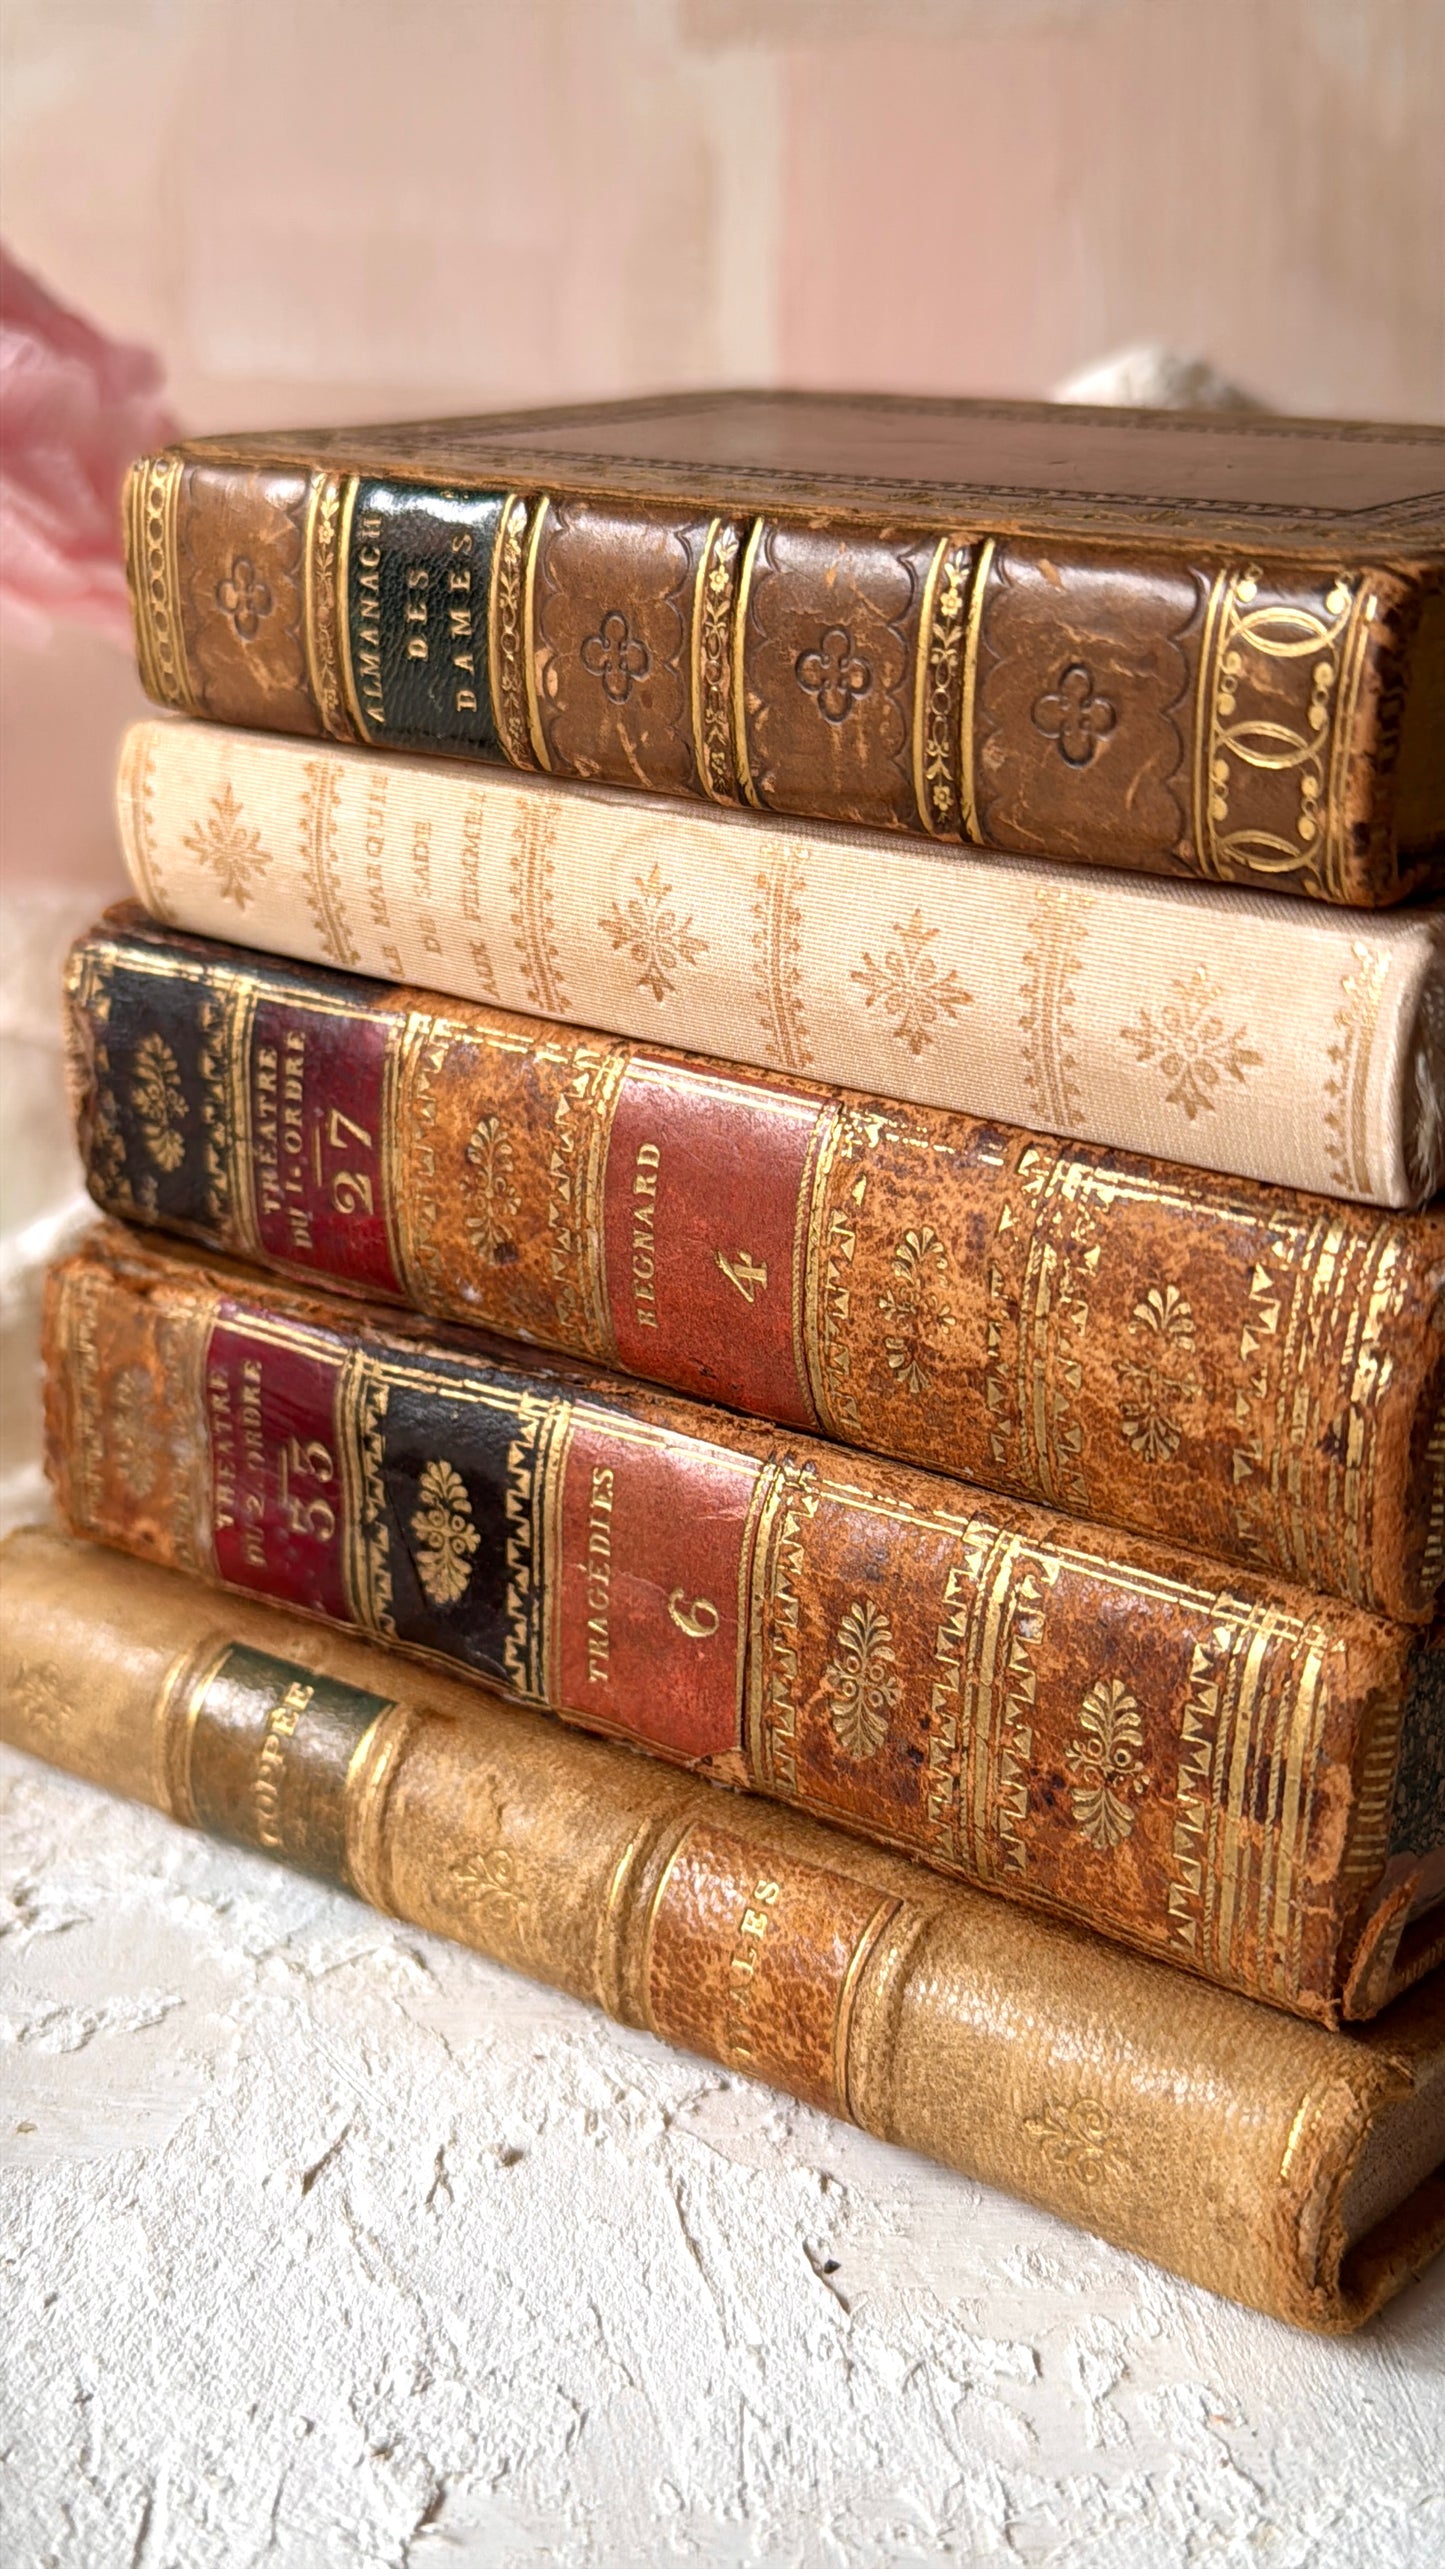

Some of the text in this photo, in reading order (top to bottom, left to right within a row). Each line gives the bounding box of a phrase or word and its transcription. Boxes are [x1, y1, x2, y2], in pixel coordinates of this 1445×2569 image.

[359, 517, 385, 723] ALMANACH
[407, 570, 429, 660] DES
[449, 533, 477, 713] DAMES
[366, 776, 404, 978] LE MARQUIS
[413, 822, 442, 955] DE SADE
[470, 941, 501, 1000] AUX
[285, 1032, 306, 1154] ORDRE
[326, 1109, 373, 1215] 27
[287, 1206, 313, 1249] DU
[632, 1143, 660, 1329] REGNARD
[716, 1251, 768, 1303] 4
[288, 1437, 335, 1542] 55
[245, 1525, 266, 1567] DU
[579, 1467, 614, 1683] TRAGÉDIES
[668, 1586, 720, 1637] 6
